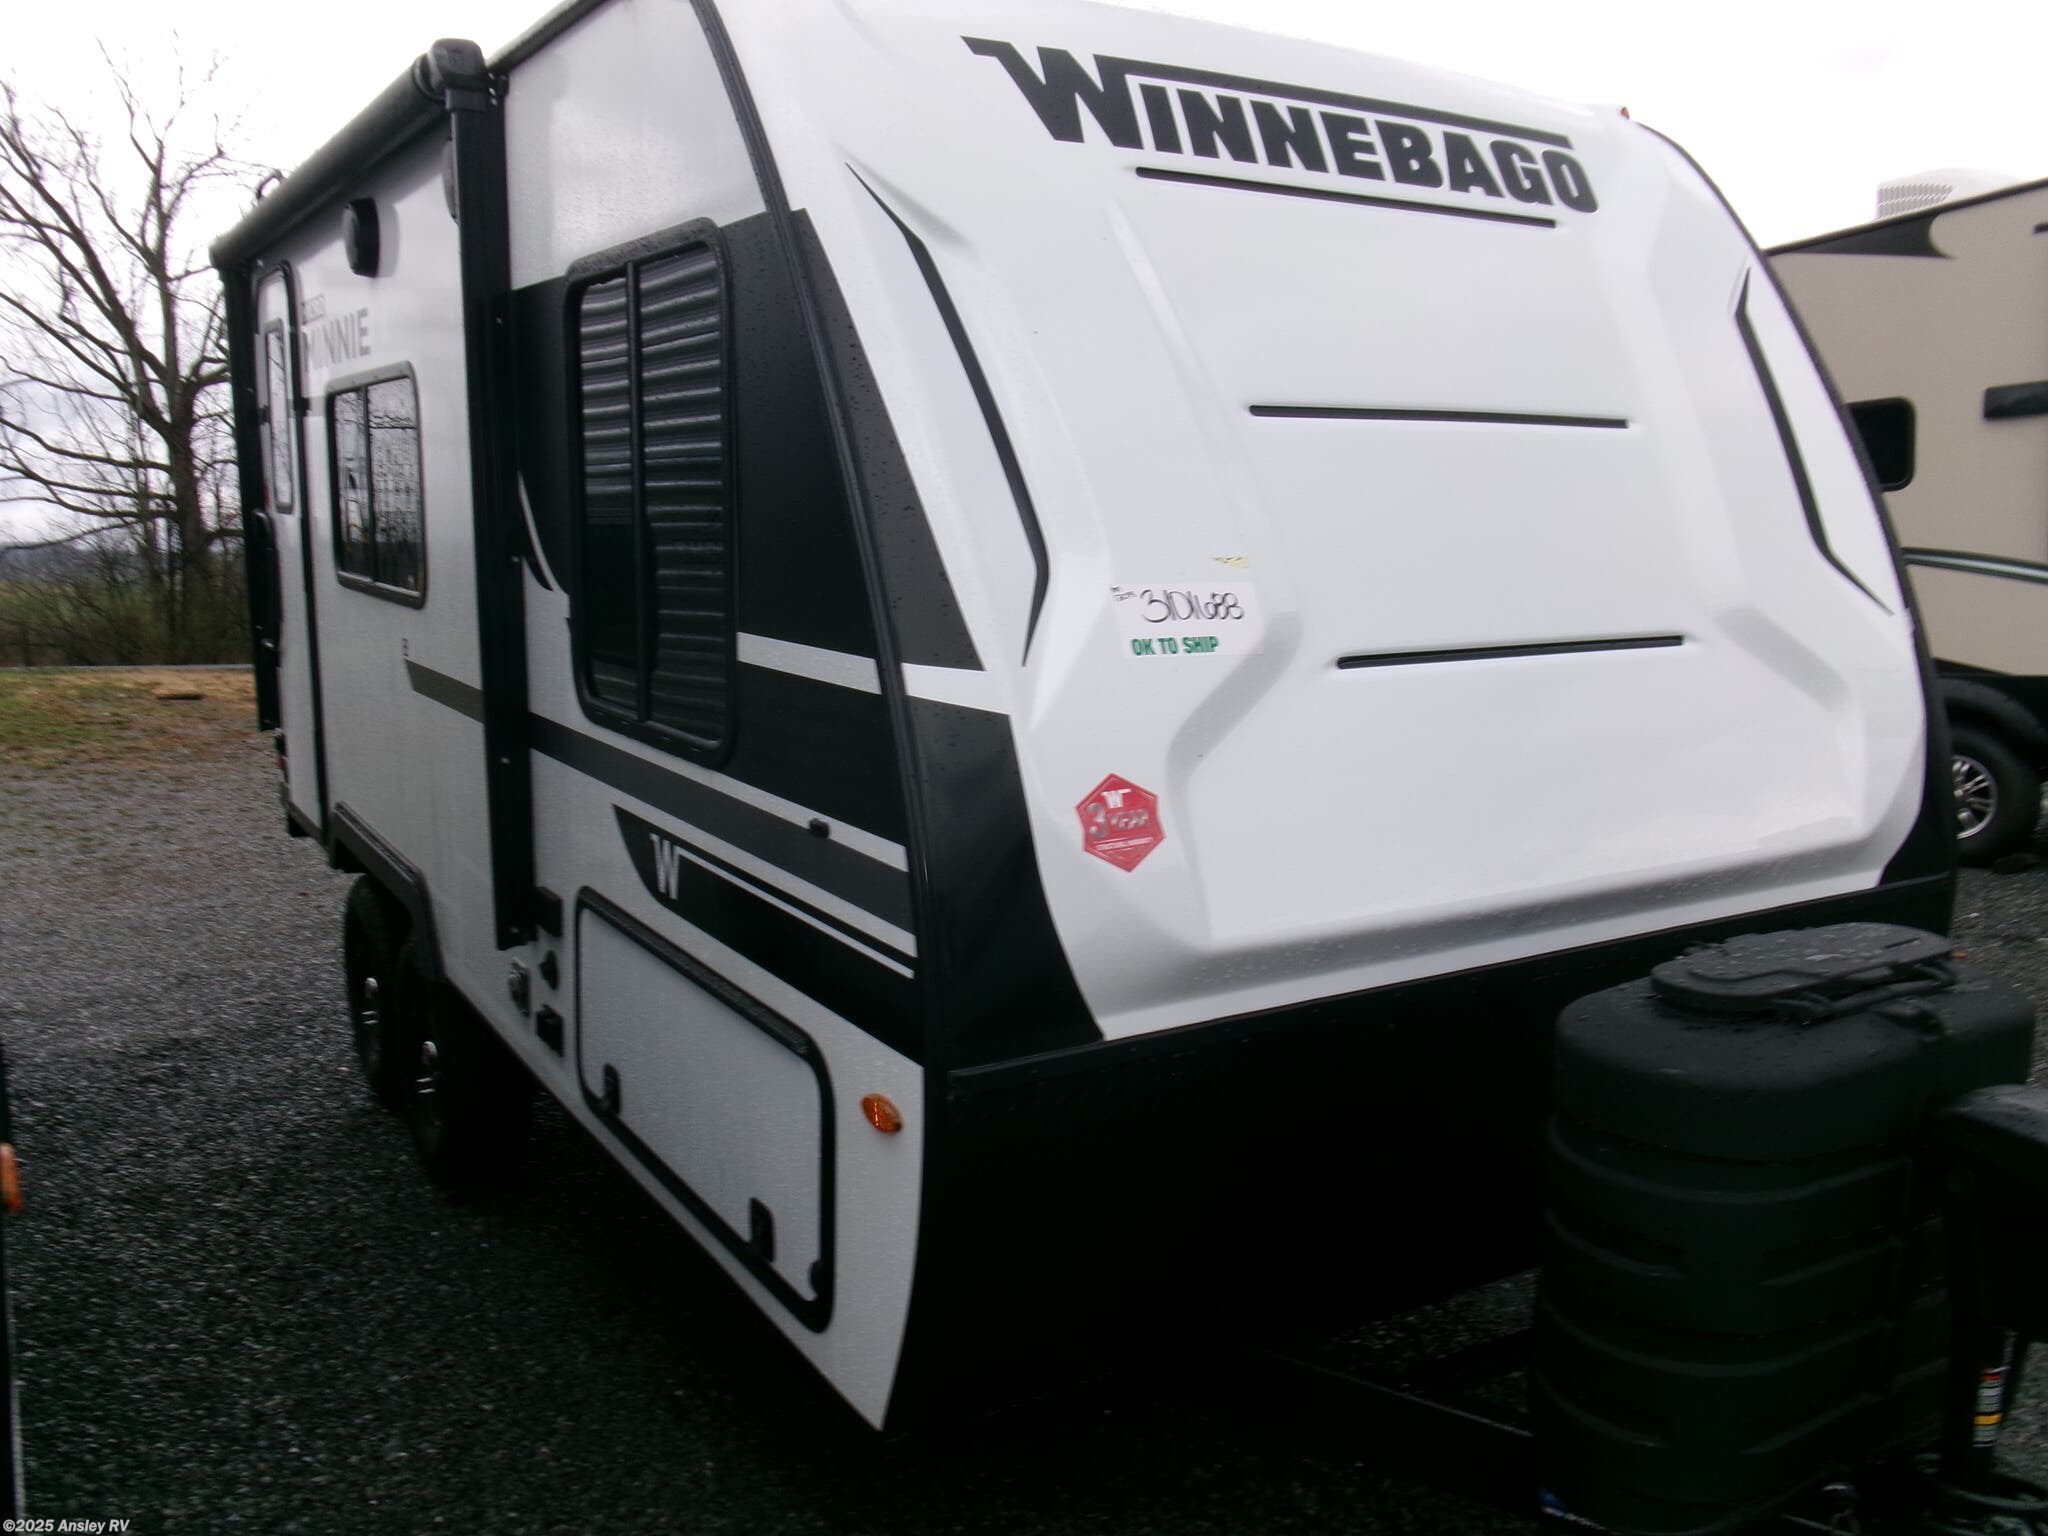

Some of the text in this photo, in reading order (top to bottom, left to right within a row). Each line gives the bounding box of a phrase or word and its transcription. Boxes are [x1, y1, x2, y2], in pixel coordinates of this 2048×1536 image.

[960, 35, 1600, 214] WINNEBAGO
[1130, 635, 1219, 656] OK TO SHIP
